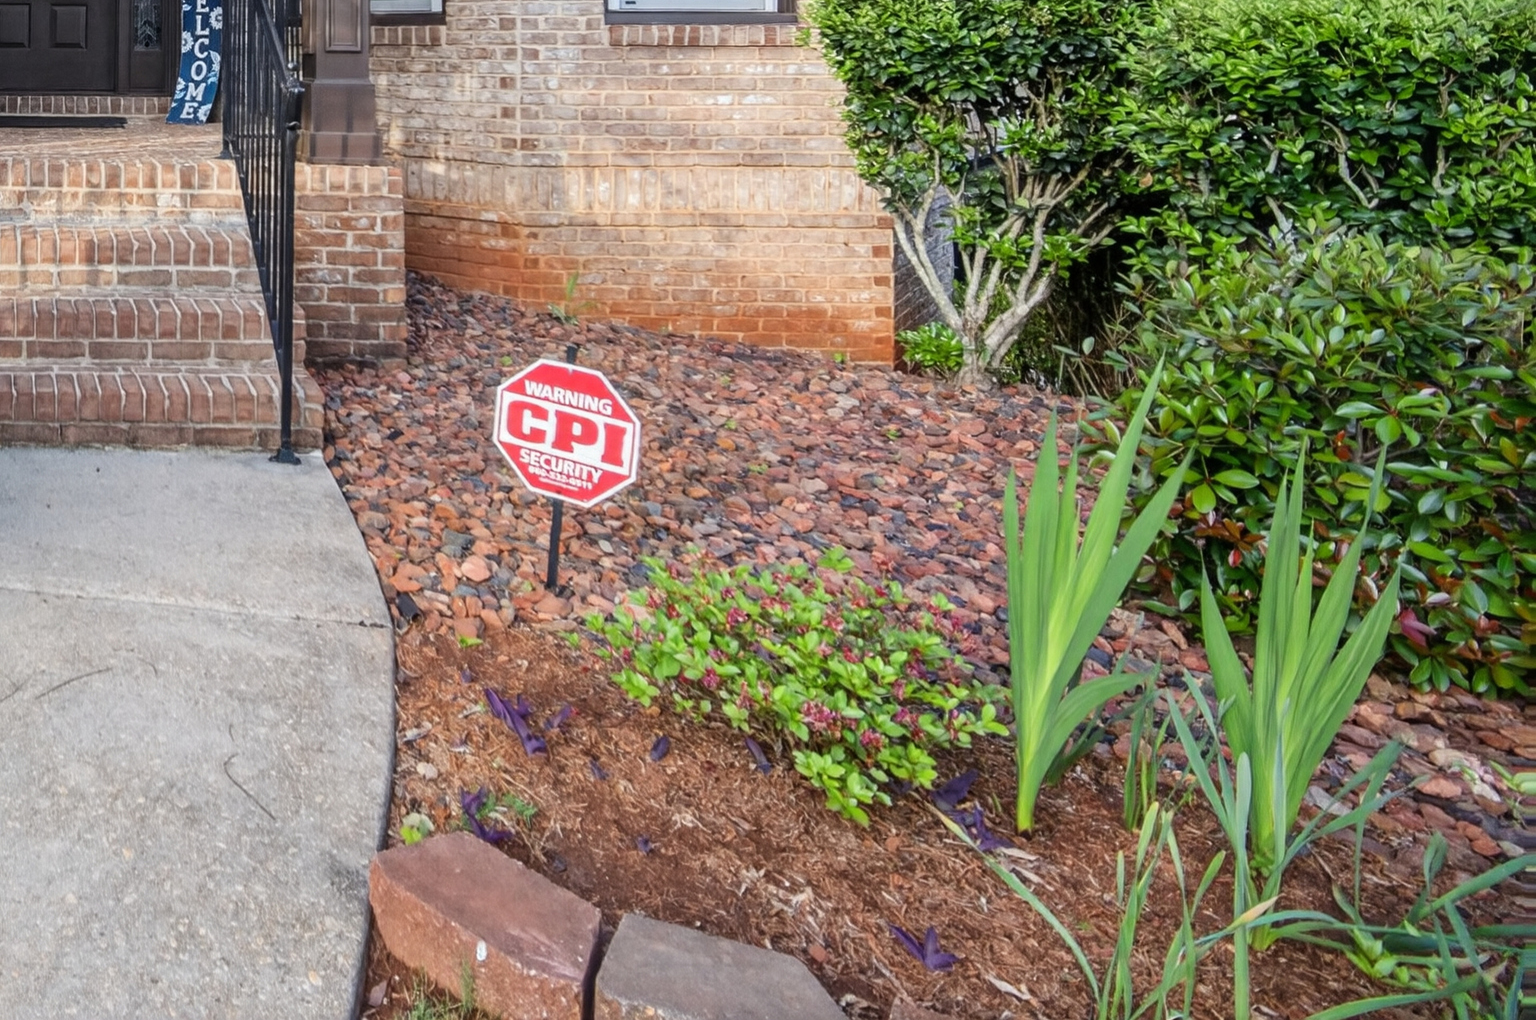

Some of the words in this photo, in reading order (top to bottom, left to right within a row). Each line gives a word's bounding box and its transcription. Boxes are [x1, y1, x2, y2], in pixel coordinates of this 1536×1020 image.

[524, 379, 613, 416] WARNING
[506, 399, 628, 468] CPI
[519, 448, 603, 484] SECURITY
